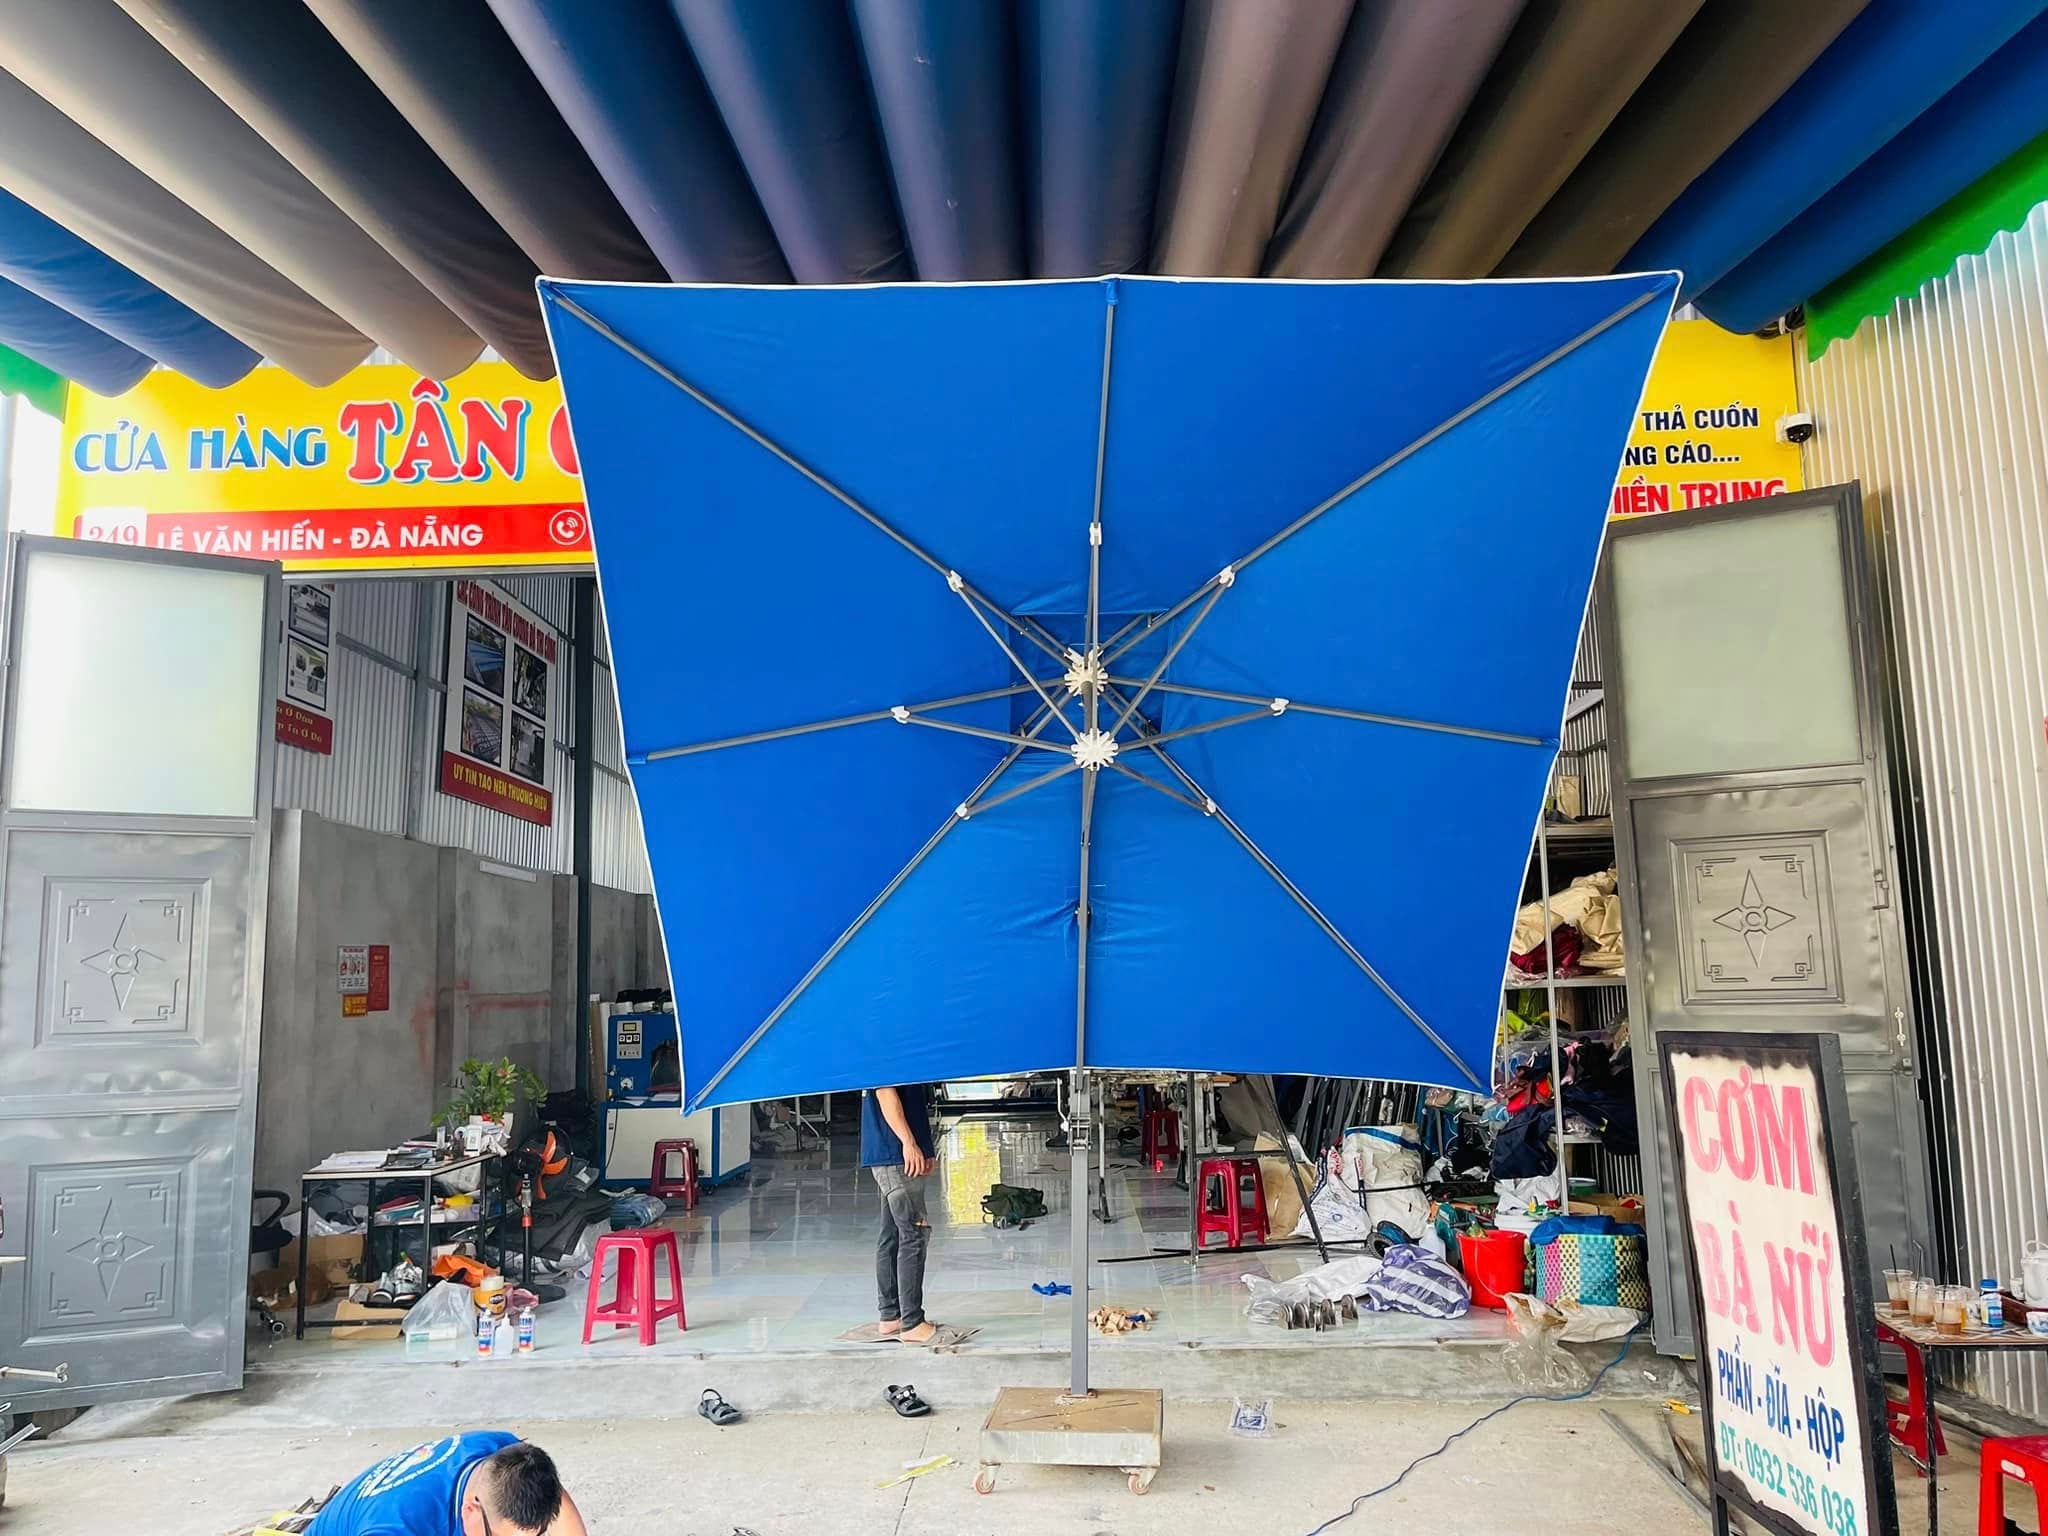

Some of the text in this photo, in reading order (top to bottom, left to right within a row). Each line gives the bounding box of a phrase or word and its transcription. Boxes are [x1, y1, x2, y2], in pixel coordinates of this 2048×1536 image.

[74, 420, 167, 472] CỬA
[190, 415, 327, 471] HÀNG
[339, 377, 531, 484] TÂN
[1623, 440, 1740, 466] NG CÁO....
[1641, 401, 1759, 431] THẢ CUỐN
[192, 525, 252, 553] VĂN
[261, 519, 325, 552] HIẾN
[350, 520, 391, 549] ĐÀ
[400, 515, 484, 548] NẴNG
[1684, 1066, 1817, 1196] CƠM
[1696, 1200, 1834, 1368] BÀ NỮ
[1717, 1335, 1753, 1416] PHẦN
[1765, 1364, 1792, 1438] ĐĨA
[1804, 1386, 1845, 1472] HỘP
[1745, 1438, 1787, 1497] 0932
[1786, 1462, 1818, 1519] 536
[1821, 1484, 1857, 1536] 038
